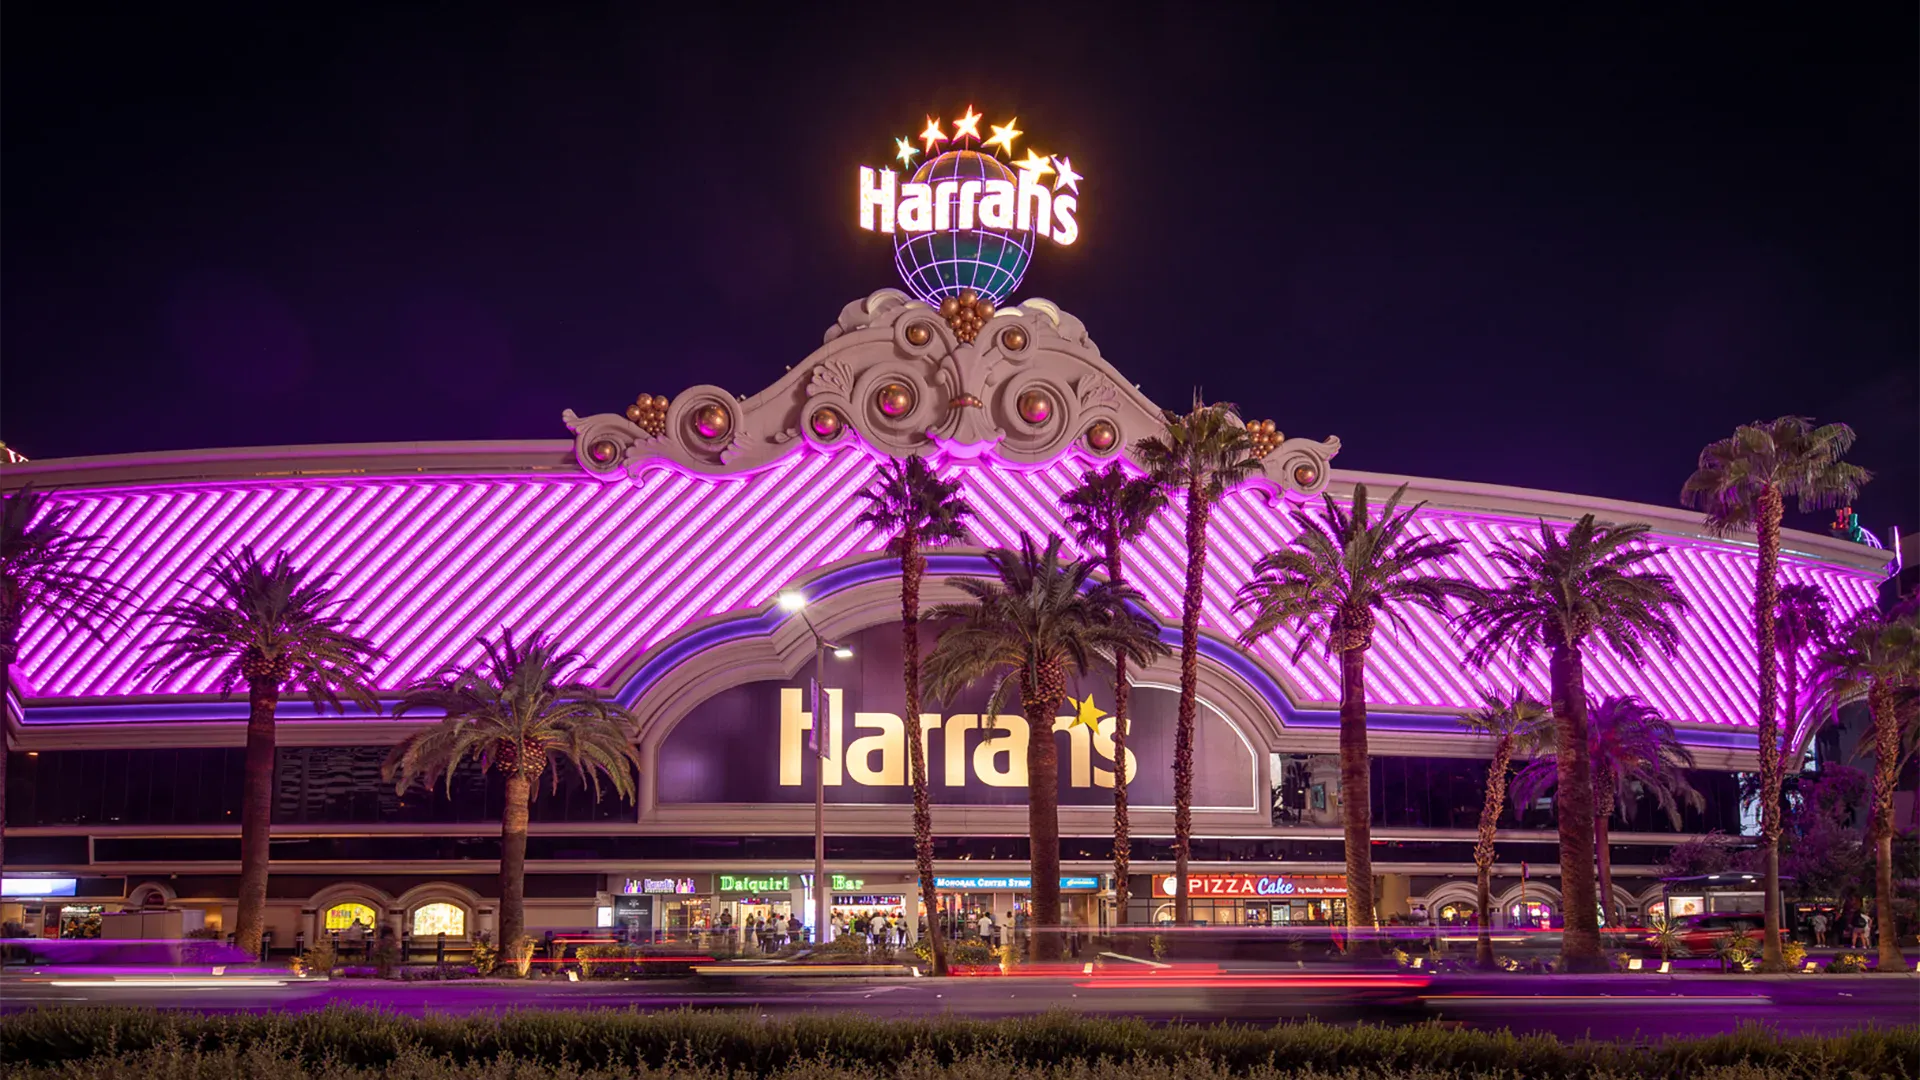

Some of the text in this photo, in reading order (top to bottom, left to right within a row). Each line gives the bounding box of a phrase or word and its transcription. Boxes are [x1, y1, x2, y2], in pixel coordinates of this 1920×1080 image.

[720, 874, 864, 894] Daiquiri Bar
[1188, 878, 1255, 894] PIZZA
[1257, 877, 1294, 896] Cake
